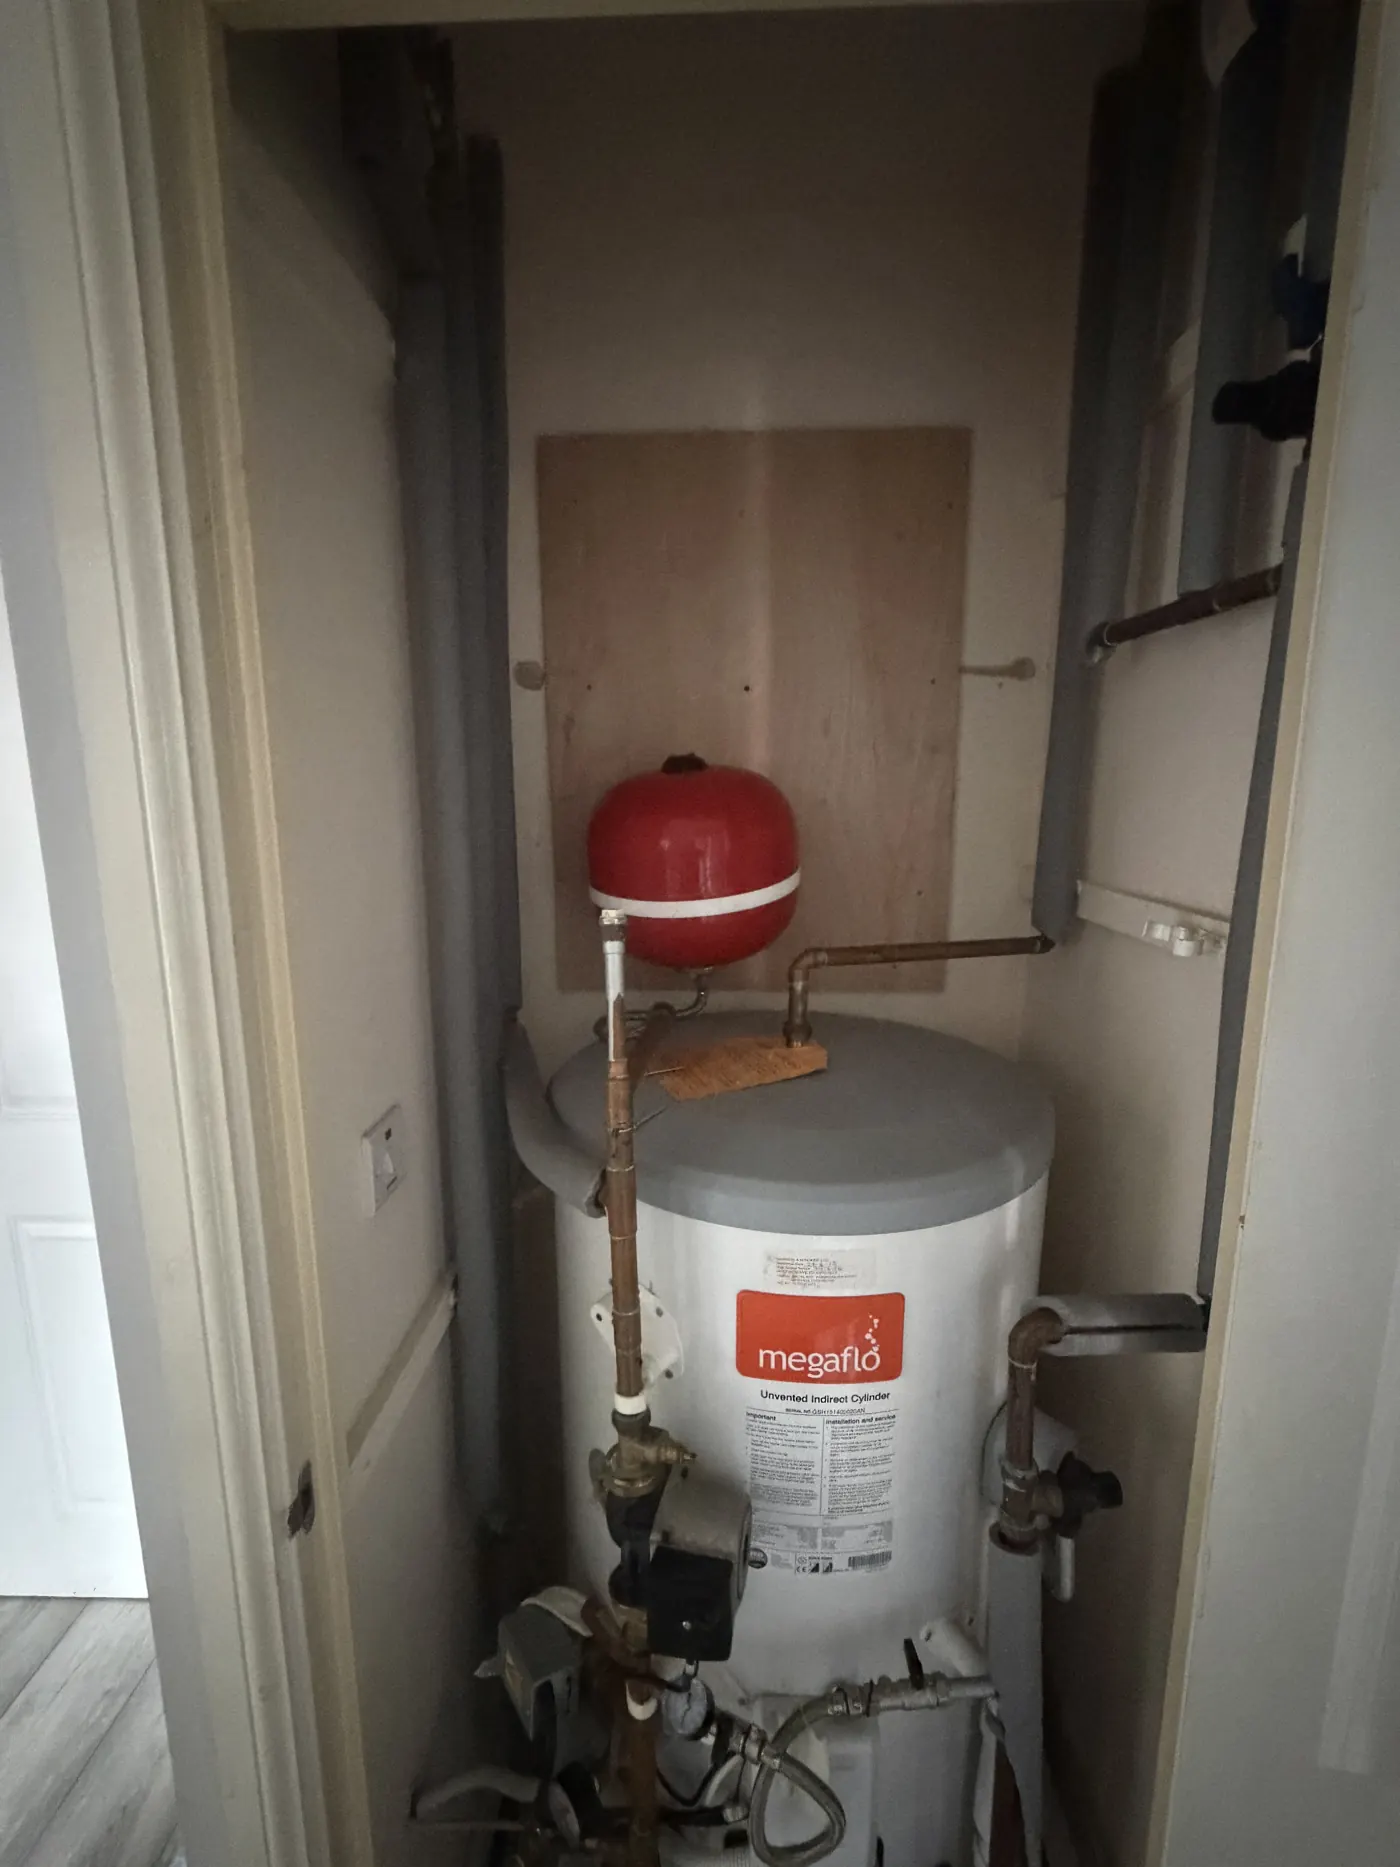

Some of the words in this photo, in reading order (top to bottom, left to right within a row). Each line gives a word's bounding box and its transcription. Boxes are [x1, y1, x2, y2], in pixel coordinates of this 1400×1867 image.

[759, 1345, 880, 1378] megaflo
[760, 1390, 808, 1403] Unvented
[811, 1394, 848, 1404] Indirect
[850, 1391, 890, 1404] Cylinder
